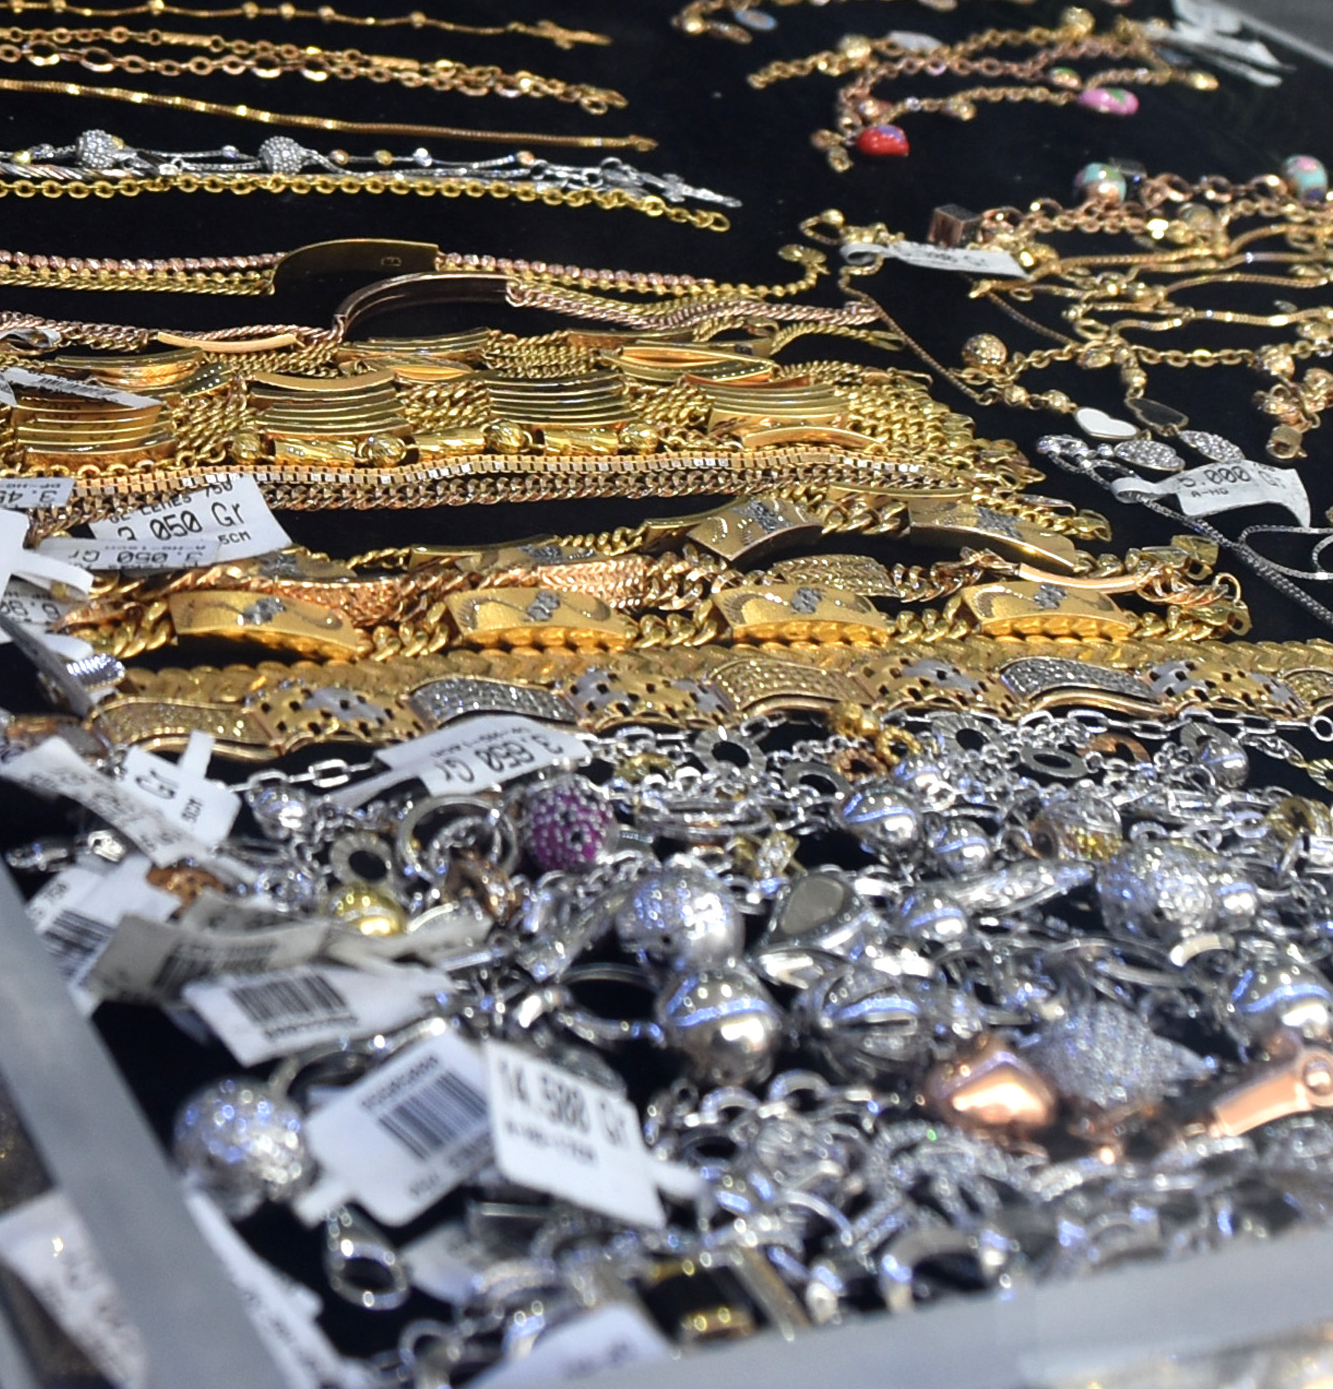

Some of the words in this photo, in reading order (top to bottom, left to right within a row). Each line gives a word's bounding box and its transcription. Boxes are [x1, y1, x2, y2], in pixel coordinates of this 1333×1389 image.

[209, 496, 245, 530] Gr
[67, 547, 100, 562] Gr
[475, 736, 563, 769] 3.650
[433, 760, 473, 782] Gr
